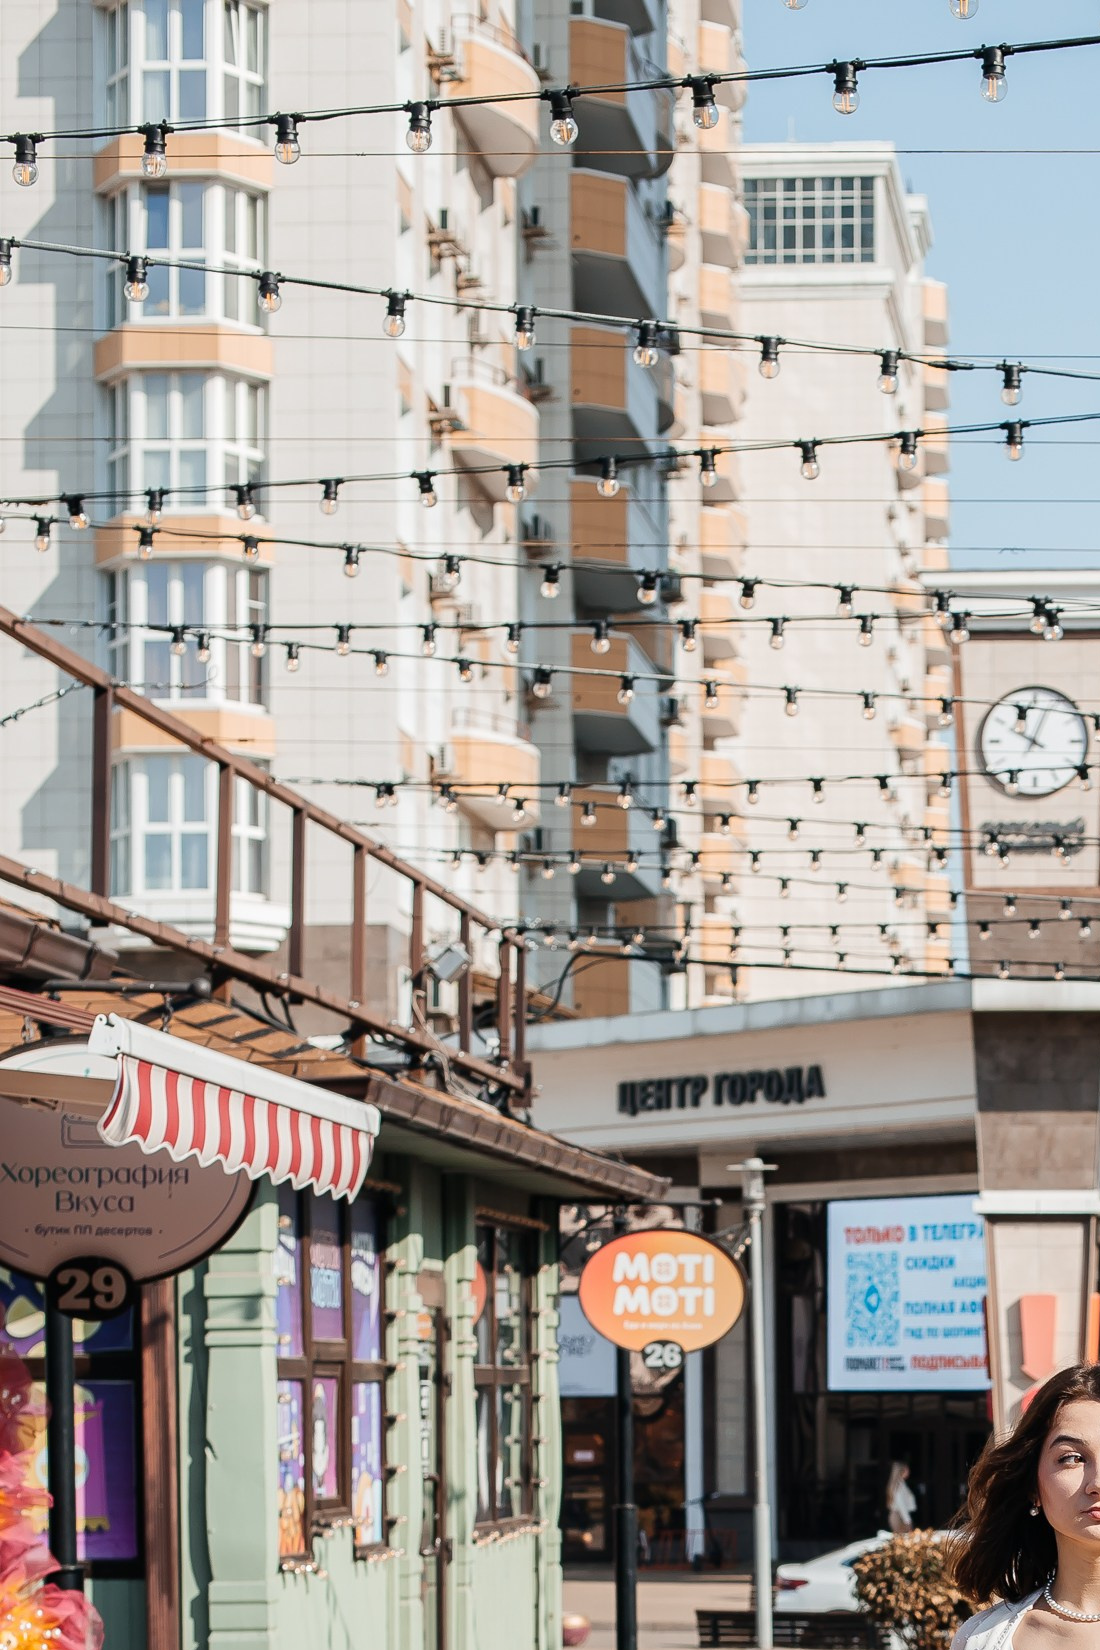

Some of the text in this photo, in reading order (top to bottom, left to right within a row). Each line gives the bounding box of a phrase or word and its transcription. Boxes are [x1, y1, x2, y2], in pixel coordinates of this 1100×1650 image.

[618, 1064, 826, 1117] ЦЕНТР ГОРОДА
[1, 1162, 189, 1189] Хореография
[55, 1189, 135, 1217] Вкуса
[34, 1223, 153, 1238] бутик ПП десертов
[846, 1226, 903, 1243] ТОЛЬКО
[909, 1225, 917, 1241] В
[612, 1251, 715, 1284] MOTI
[905, 1256, 954, 1270] СКИДКИ
[56, 1266, 127, 1310] 29
[612, 1285, 716, 1317] MOTI
[644, 1343, 682, 1368] 26
